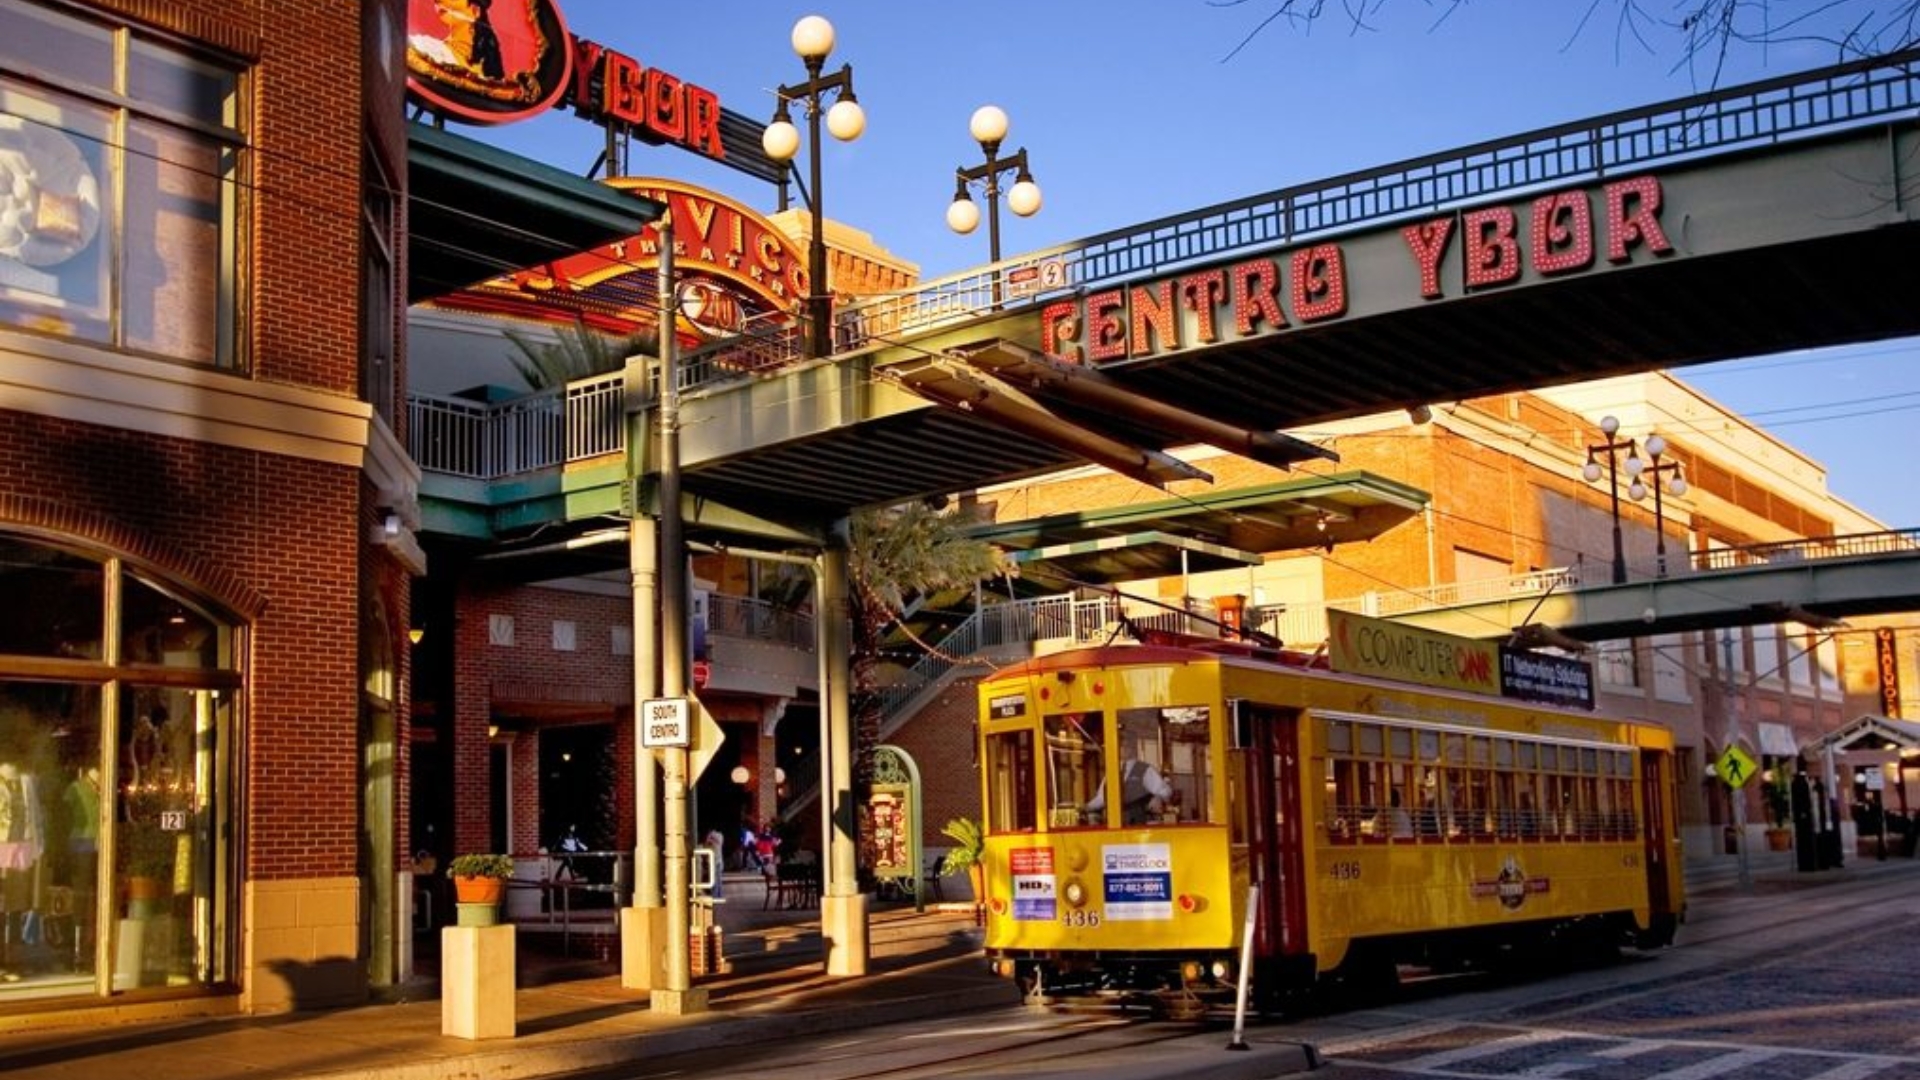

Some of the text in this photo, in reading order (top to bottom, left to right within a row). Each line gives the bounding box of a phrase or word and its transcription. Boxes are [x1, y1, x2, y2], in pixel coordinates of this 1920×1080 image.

[570, 34, 725, 158] YBOR
[1041, 175, 1674, 366] CENTRO YBOR
[653, 704, 678, 720] SOUTH
[650, 723, 679, 739] CENTRO
[163, 813, 185, 829] 121
[1330, 861, 1361, 880] 436
[1063, 909, 1099, 927] 436
